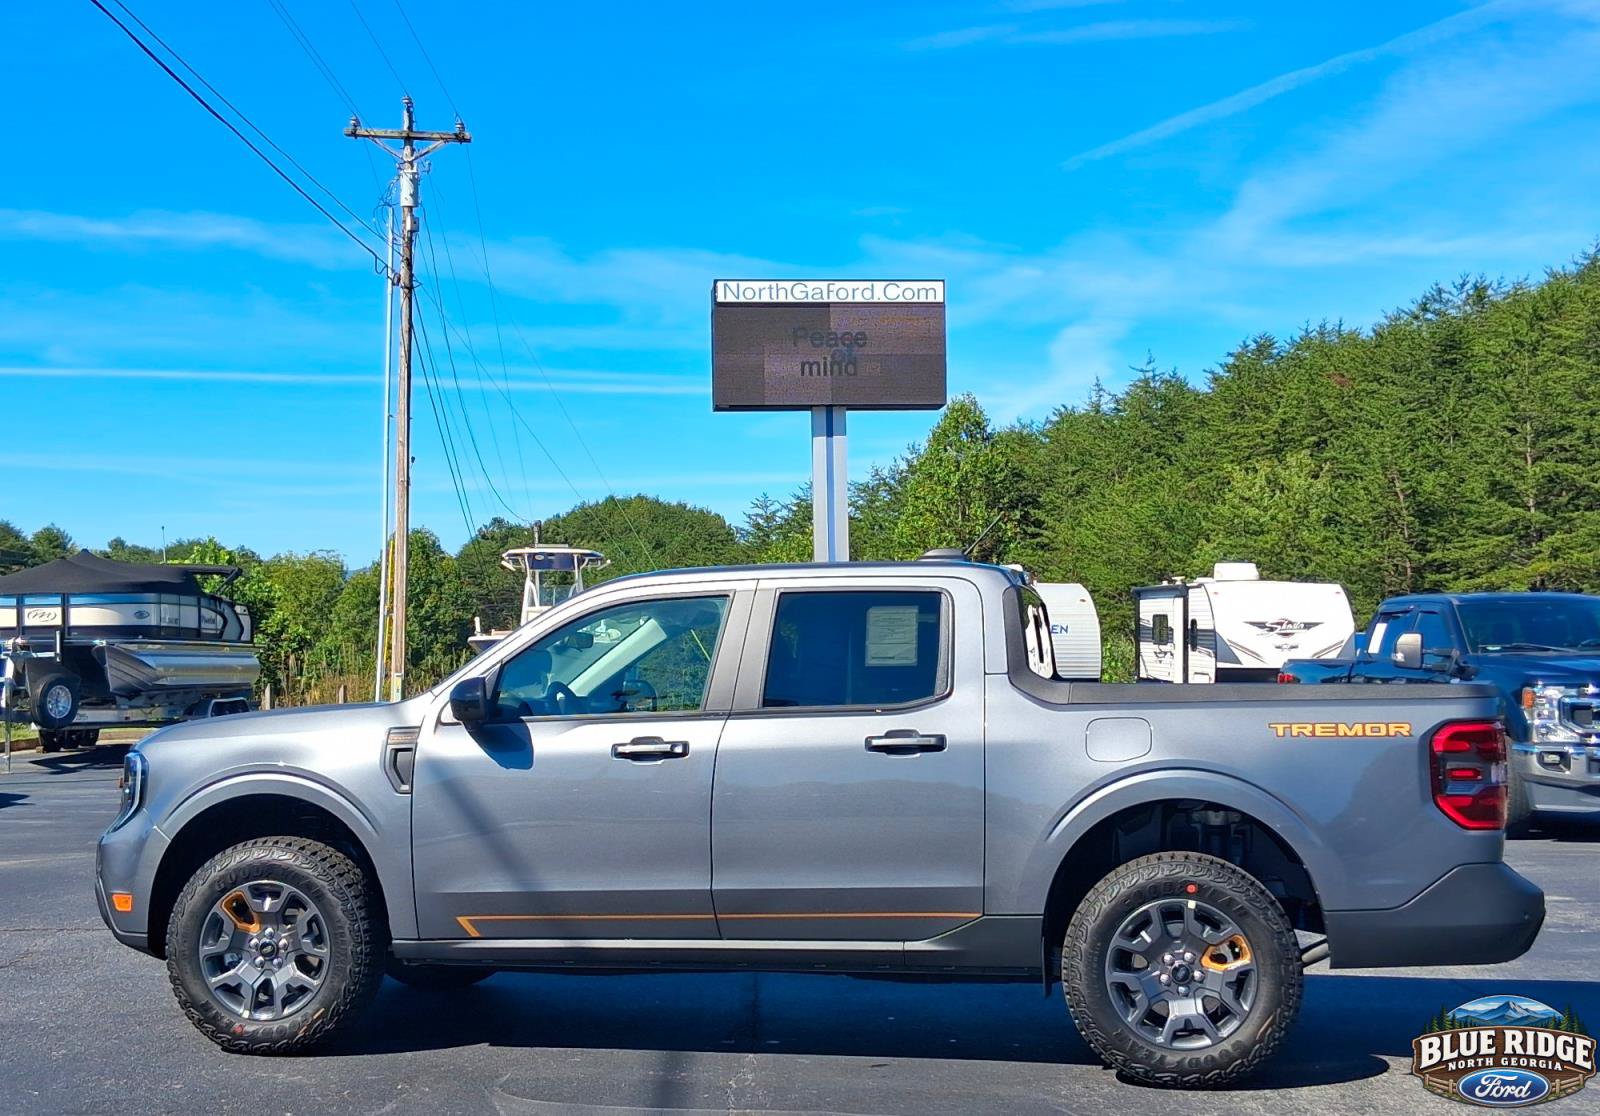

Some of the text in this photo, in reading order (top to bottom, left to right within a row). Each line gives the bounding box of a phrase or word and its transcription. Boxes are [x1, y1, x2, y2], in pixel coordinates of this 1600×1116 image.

[792, 327, 868, 348] Peace
[800, 356, 858, 377] mind
[1268, 722, 1413, 738] TREMOR
